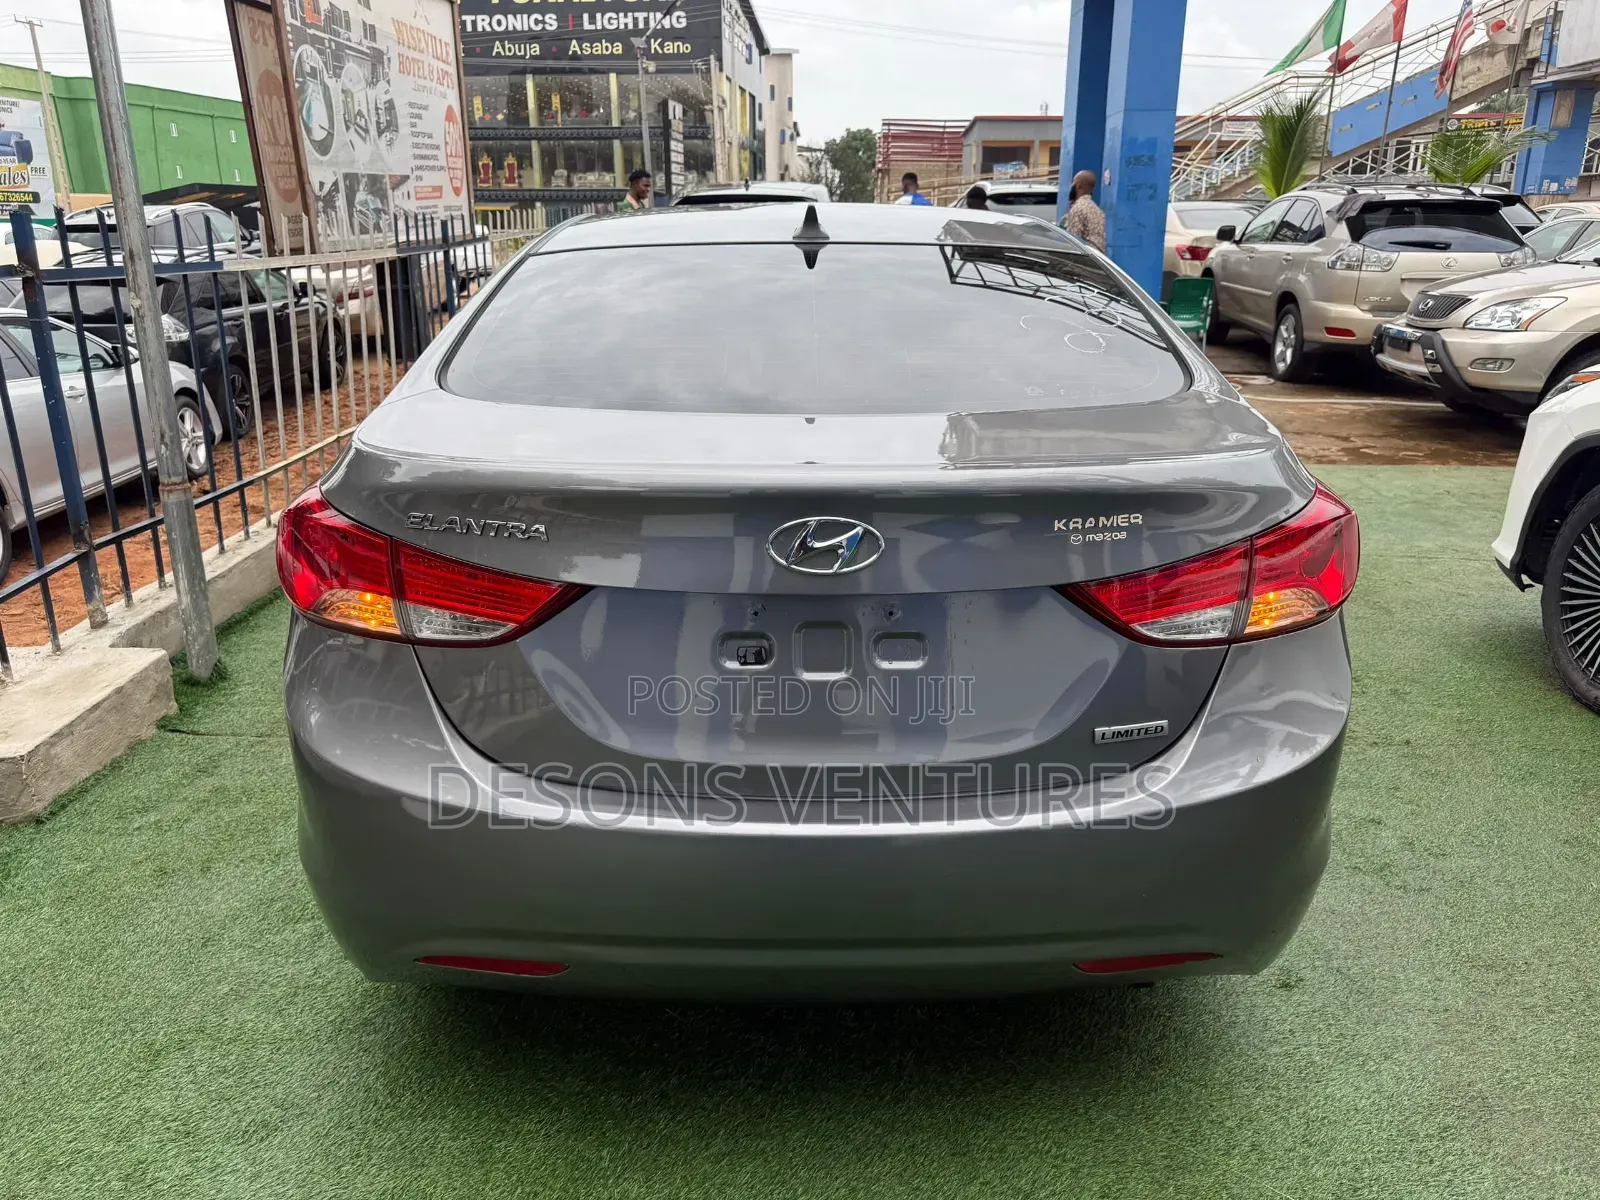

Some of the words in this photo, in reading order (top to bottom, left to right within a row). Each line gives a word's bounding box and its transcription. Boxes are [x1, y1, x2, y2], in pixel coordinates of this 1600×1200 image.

[459, 14, 558, 32] TRONICS
[582, 11, 687, 30] LIGHTING
[391, 17, 452, 66] WISEVILLE
[492, 40, 540, 59] Abuja
[568, 39, 623, 56] Asaba
[650, 38, 691, 54] Kano
[397, 52, 427, 80] HOTEL
[436, 66, 454, 90] APTS
[405, 512, 549, 542] ELANTRA
[1054, 513, 1143, 531] KRAMER
[1101, 725, 1165, 741] LIMITED
